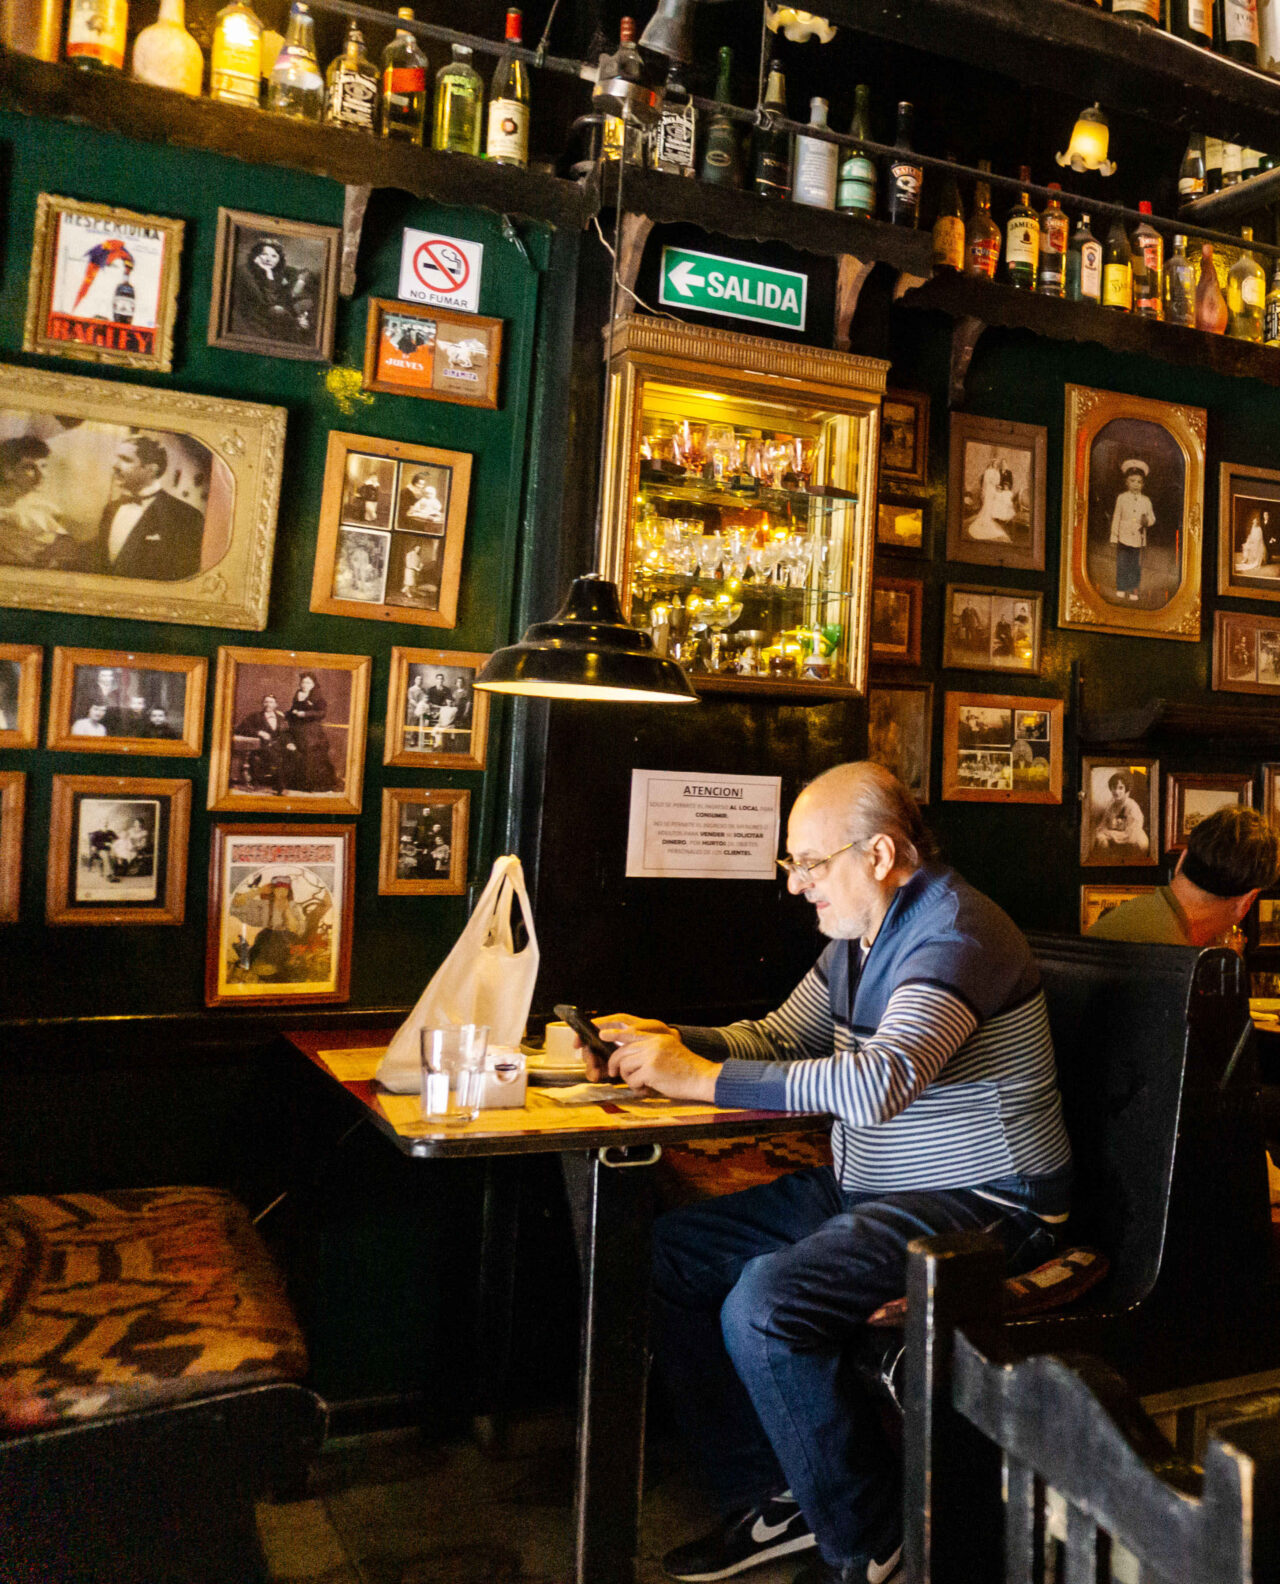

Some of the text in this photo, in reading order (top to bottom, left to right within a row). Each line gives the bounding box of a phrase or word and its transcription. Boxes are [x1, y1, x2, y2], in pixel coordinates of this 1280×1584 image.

[410, 289, 469, 308] NO FUMAR
[706, 271, 799, 314] SALIDA
[385, 357, 425, 372] JUEVES
[683, 785, 743, 798] ATENCION!
